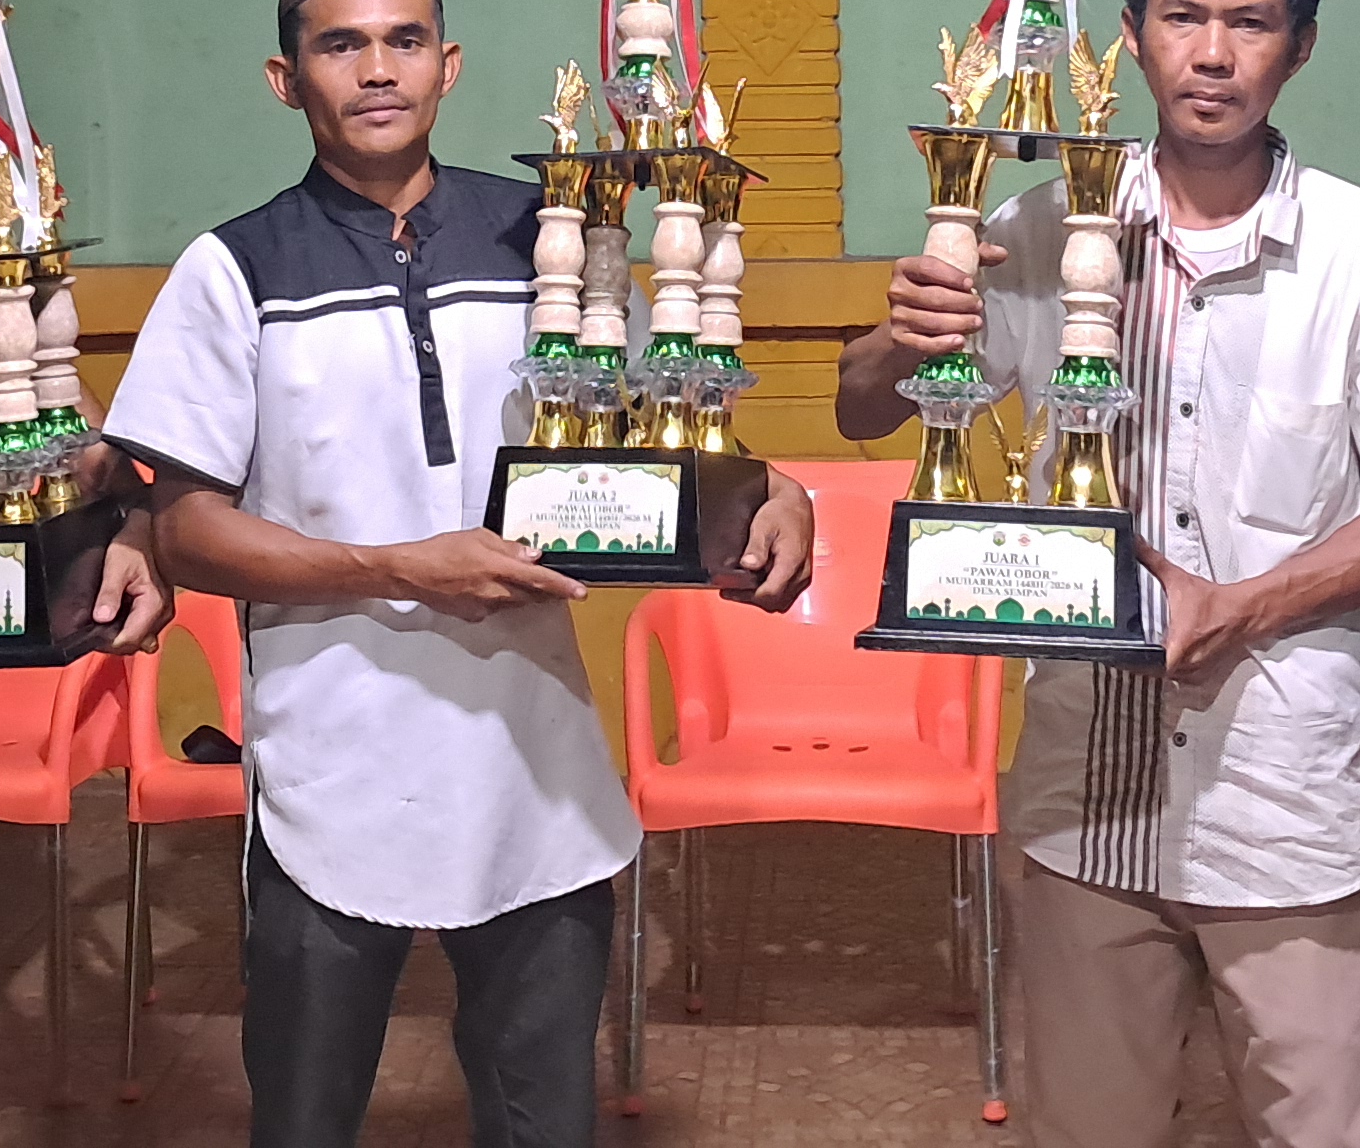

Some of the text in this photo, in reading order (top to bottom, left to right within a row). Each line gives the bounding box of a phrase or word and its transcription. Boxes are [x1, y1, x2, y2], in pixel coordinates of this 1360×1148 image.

[568, 490, 617, 502] JUARA 2
[983, 552, 1030, 565] JUARA
[946, 577, 1012, 587] MUHARRAM
